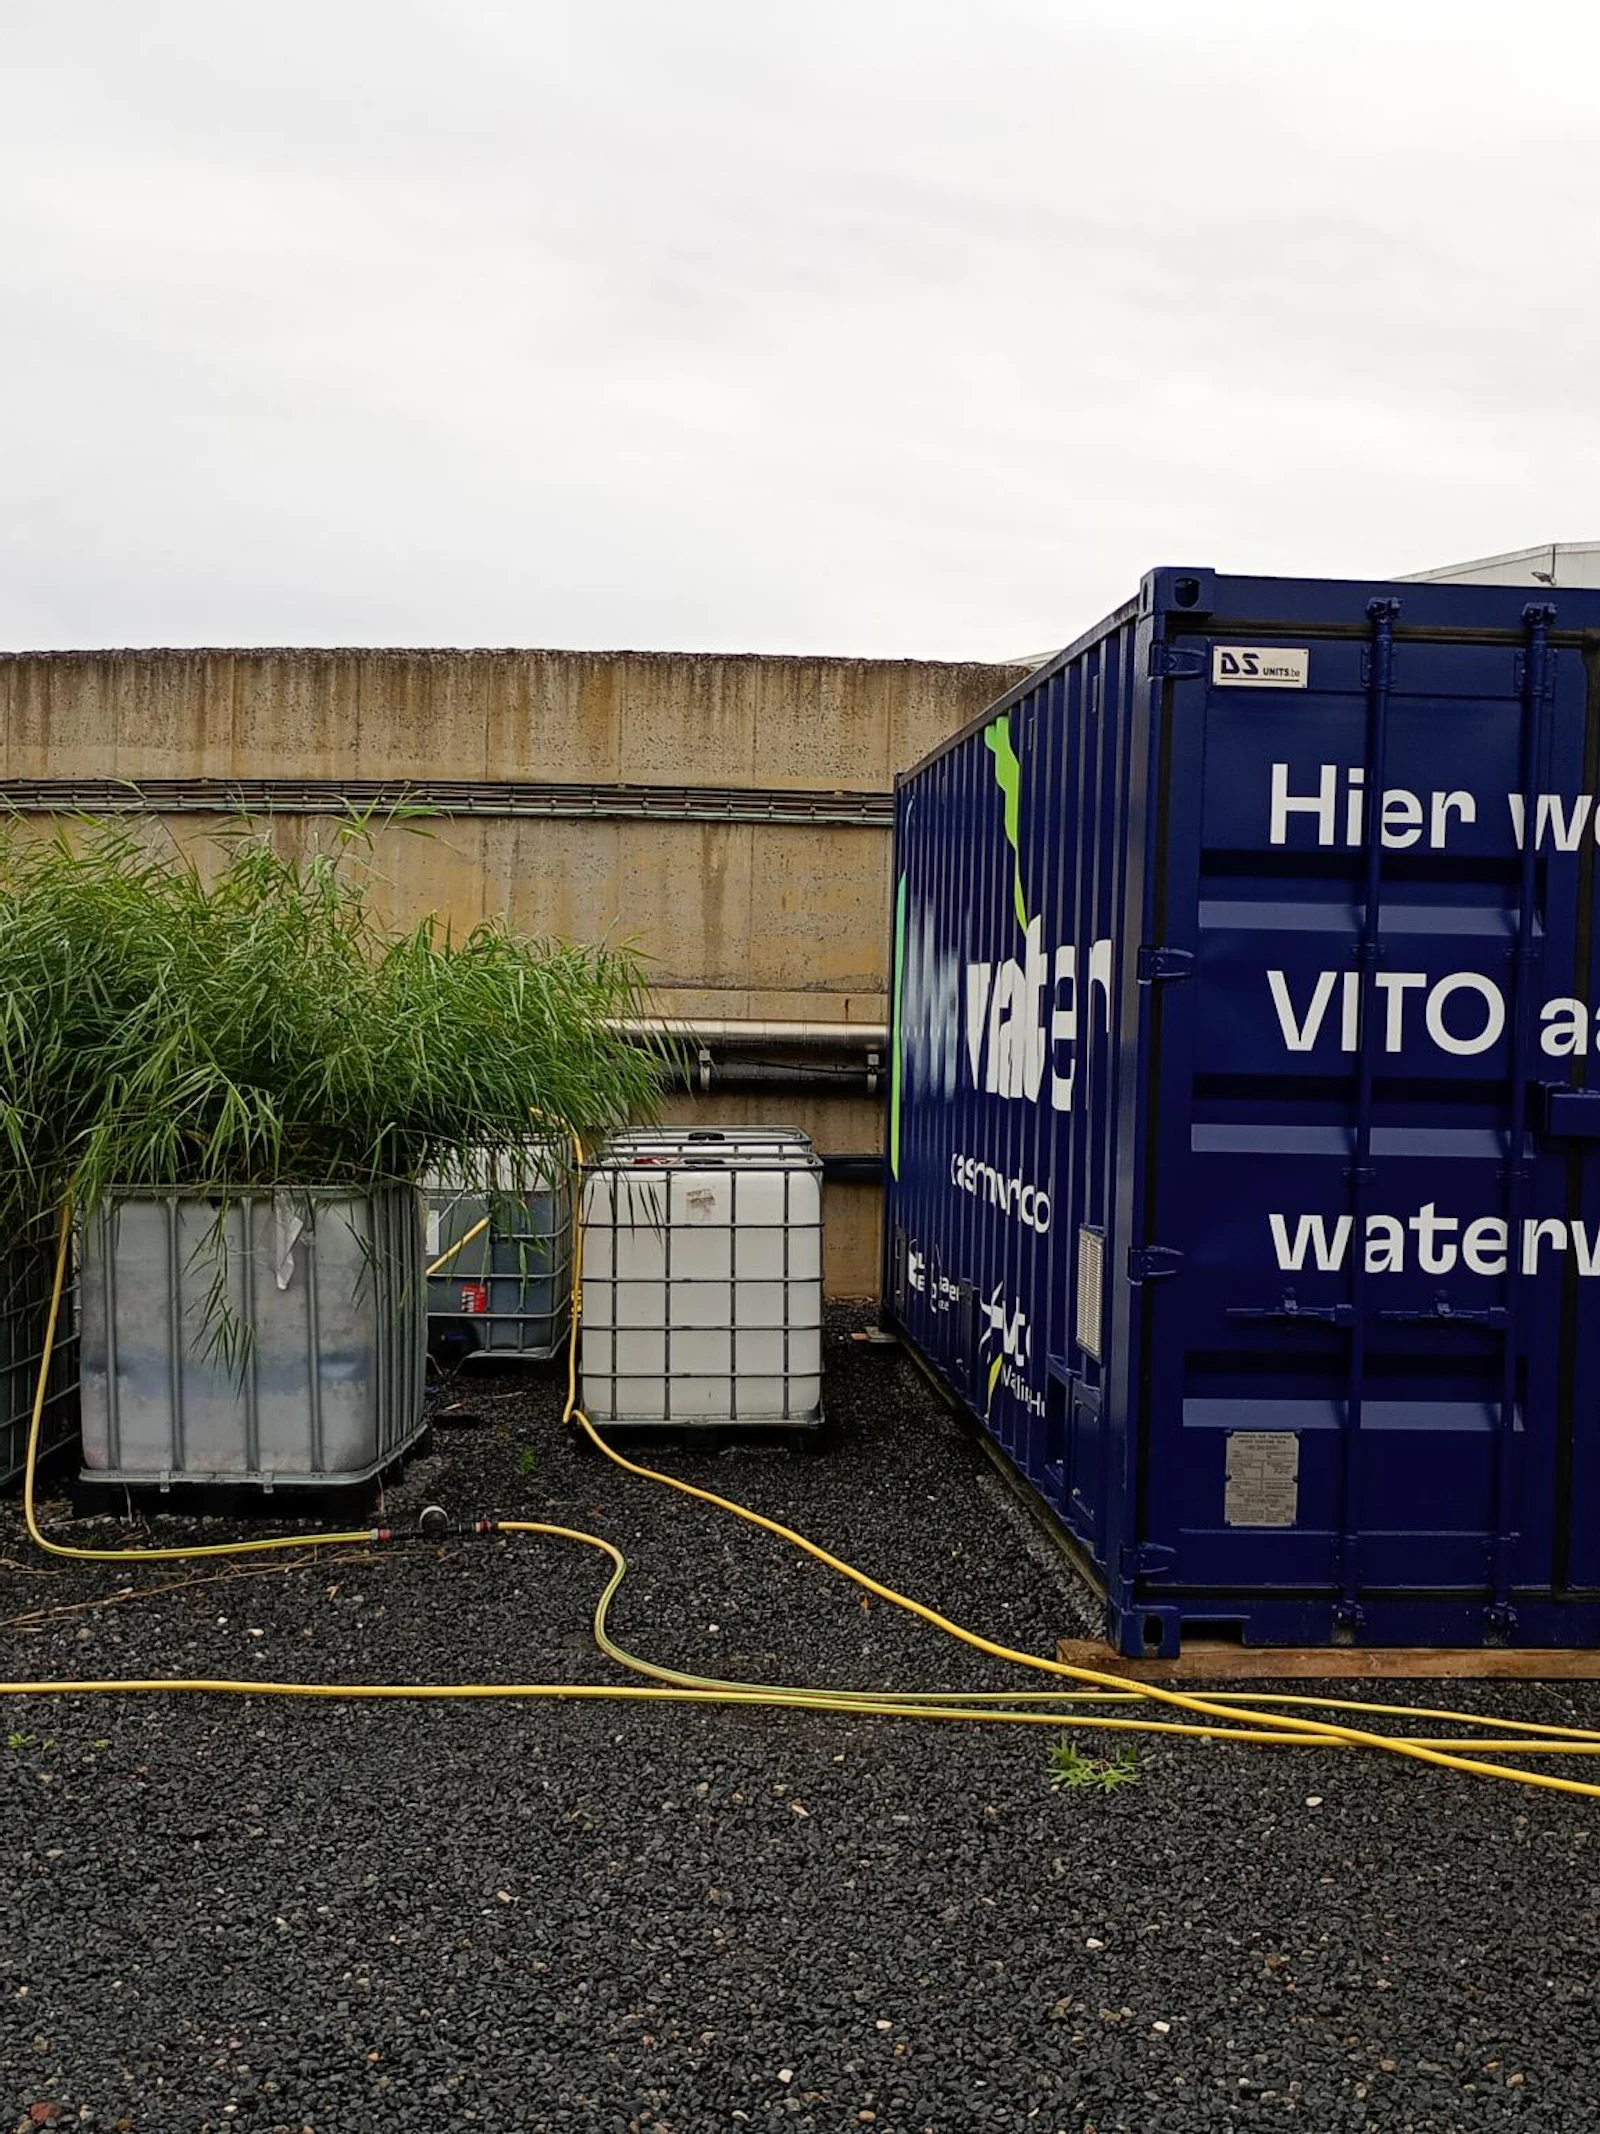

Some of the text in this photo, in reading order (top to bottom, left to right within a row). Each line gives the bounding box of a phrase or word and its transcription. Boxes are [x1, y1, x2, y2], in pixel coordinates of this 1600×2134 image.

[1221, 652, 1300, 677] DS UNITS.be
[1271, 764, 1600, 852] Hier w
[1267, 970, 1505, 1056] VITO
